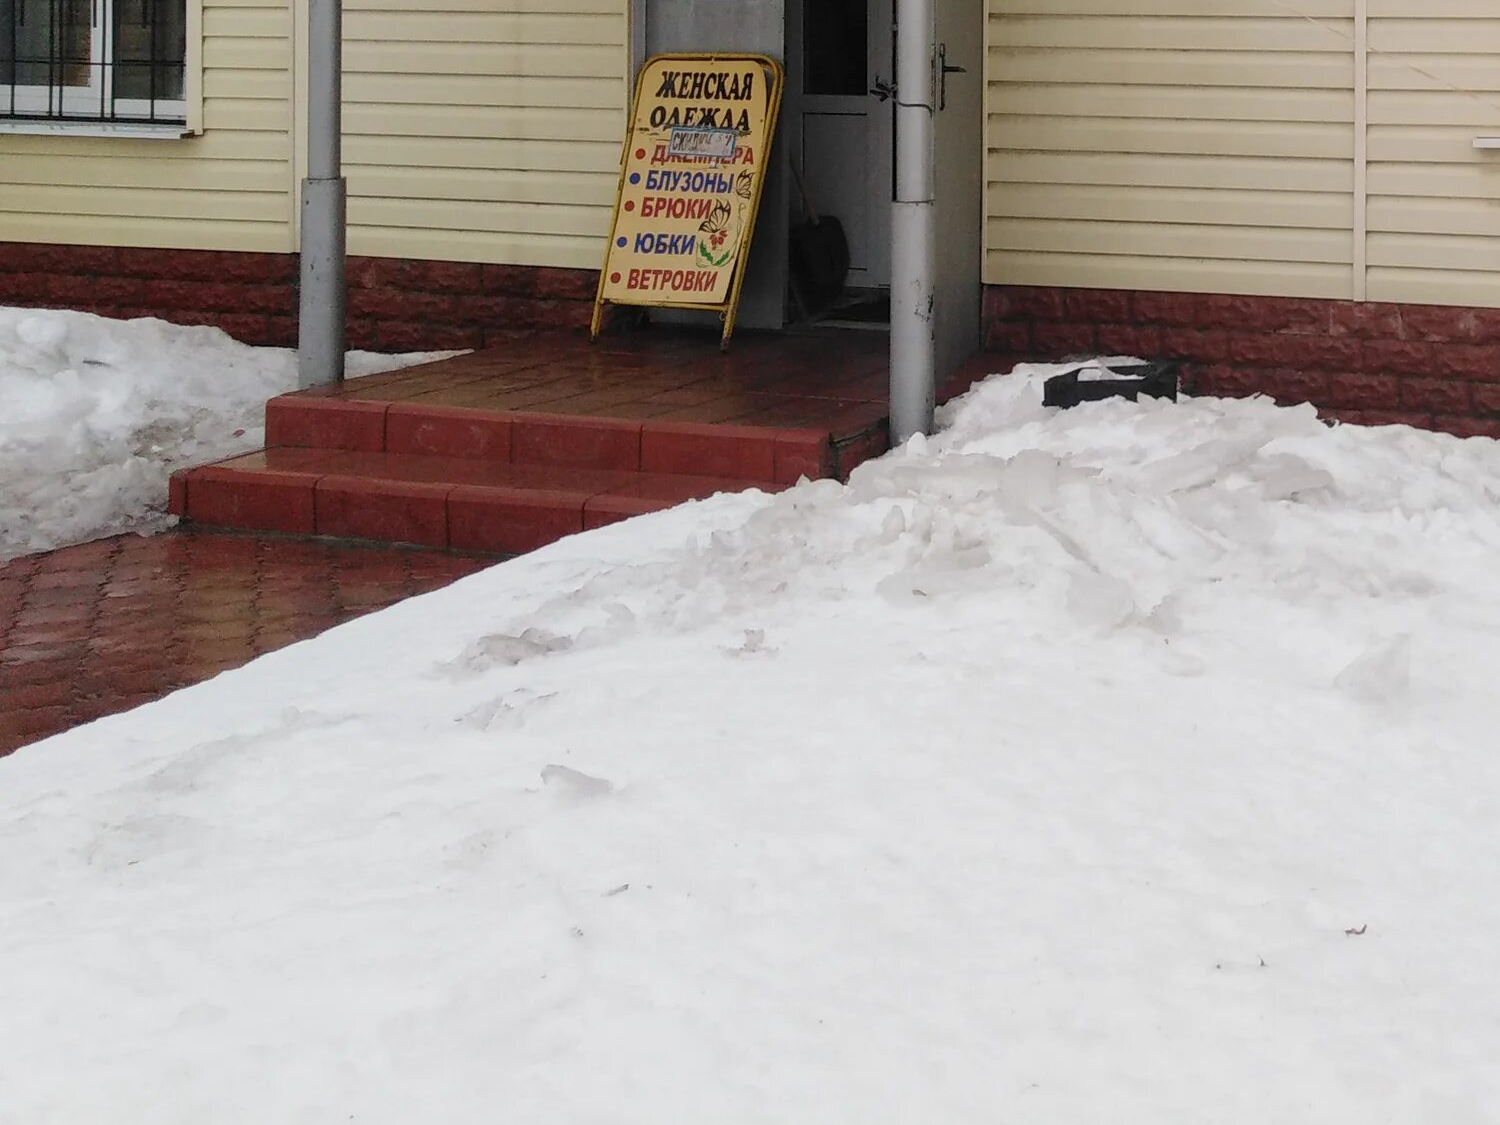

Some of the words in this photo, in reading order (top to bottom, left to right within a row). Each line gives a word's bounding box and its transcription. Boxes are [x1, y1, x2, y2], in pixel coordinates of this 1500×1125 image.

[655, 71, 754, 101] ЖЕНСКАЯ
[650, 105, 750, 132] ОДЕЖДА
[645, 170, 734, 193] БЛУЗОНЫ
[640, 197, 712, 219] БРЮКИ
[633, 233, 697, 254] ЮБКИ
[626, 268, 719, 292] ВЕТРОВКИ
